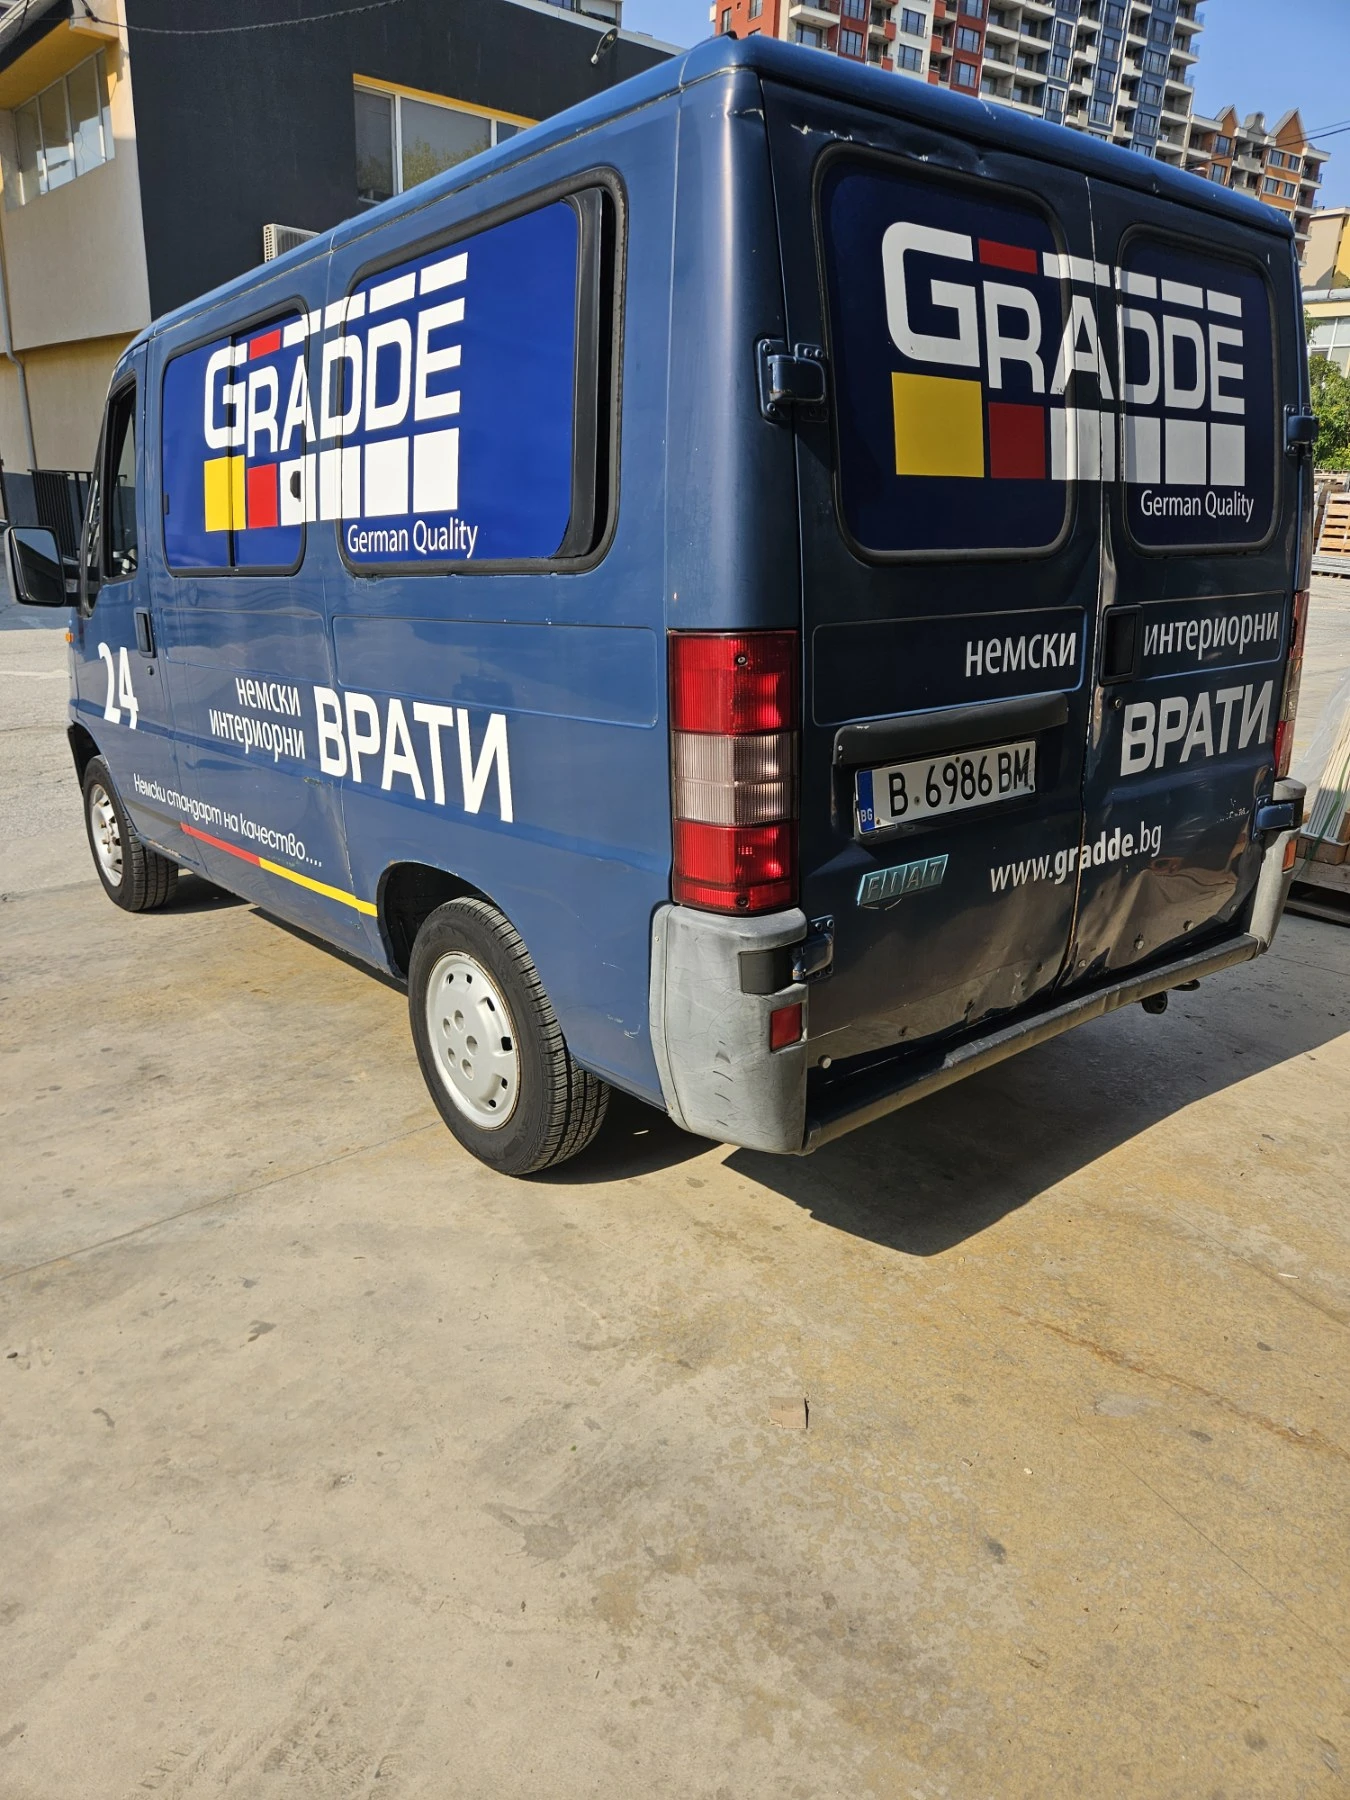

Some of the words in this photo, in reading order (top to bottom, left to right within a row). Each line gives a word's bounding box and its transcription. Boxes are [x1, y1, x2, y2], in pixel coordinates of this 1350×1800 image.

[882, 222, 1246, 416] GRADDE
[204, 297, 465, 457] GRADDE
[1141, 489, 1201, 517] German
[1205, 491, 1254, 523] Quality
[347, 524, 409, 553] German
[413, 516, 478, 559] Quality
[965, 632, 1077, 678] немски
[1144, 611, 1279, 661] интериорни
[98, 641, 139, 730] 24
[235, 677, 302, 718] немски
[208, 708, 306, 763] интериорни
[314, 685, 514, 824] ВРАТИ
[1120, 680, 1275, 777] ВРАТИ
[133, 772, 166, 803] Немски
[166, 789, 222, 826] стандарт
[224, 811, 239, 833] на
[925, 755, 993, 808] 6986
[860, 807, 873, 824] BG
[866, 860, 943, 899] FIAT
[990, 820, 1162, 893] www.gradde.bg
